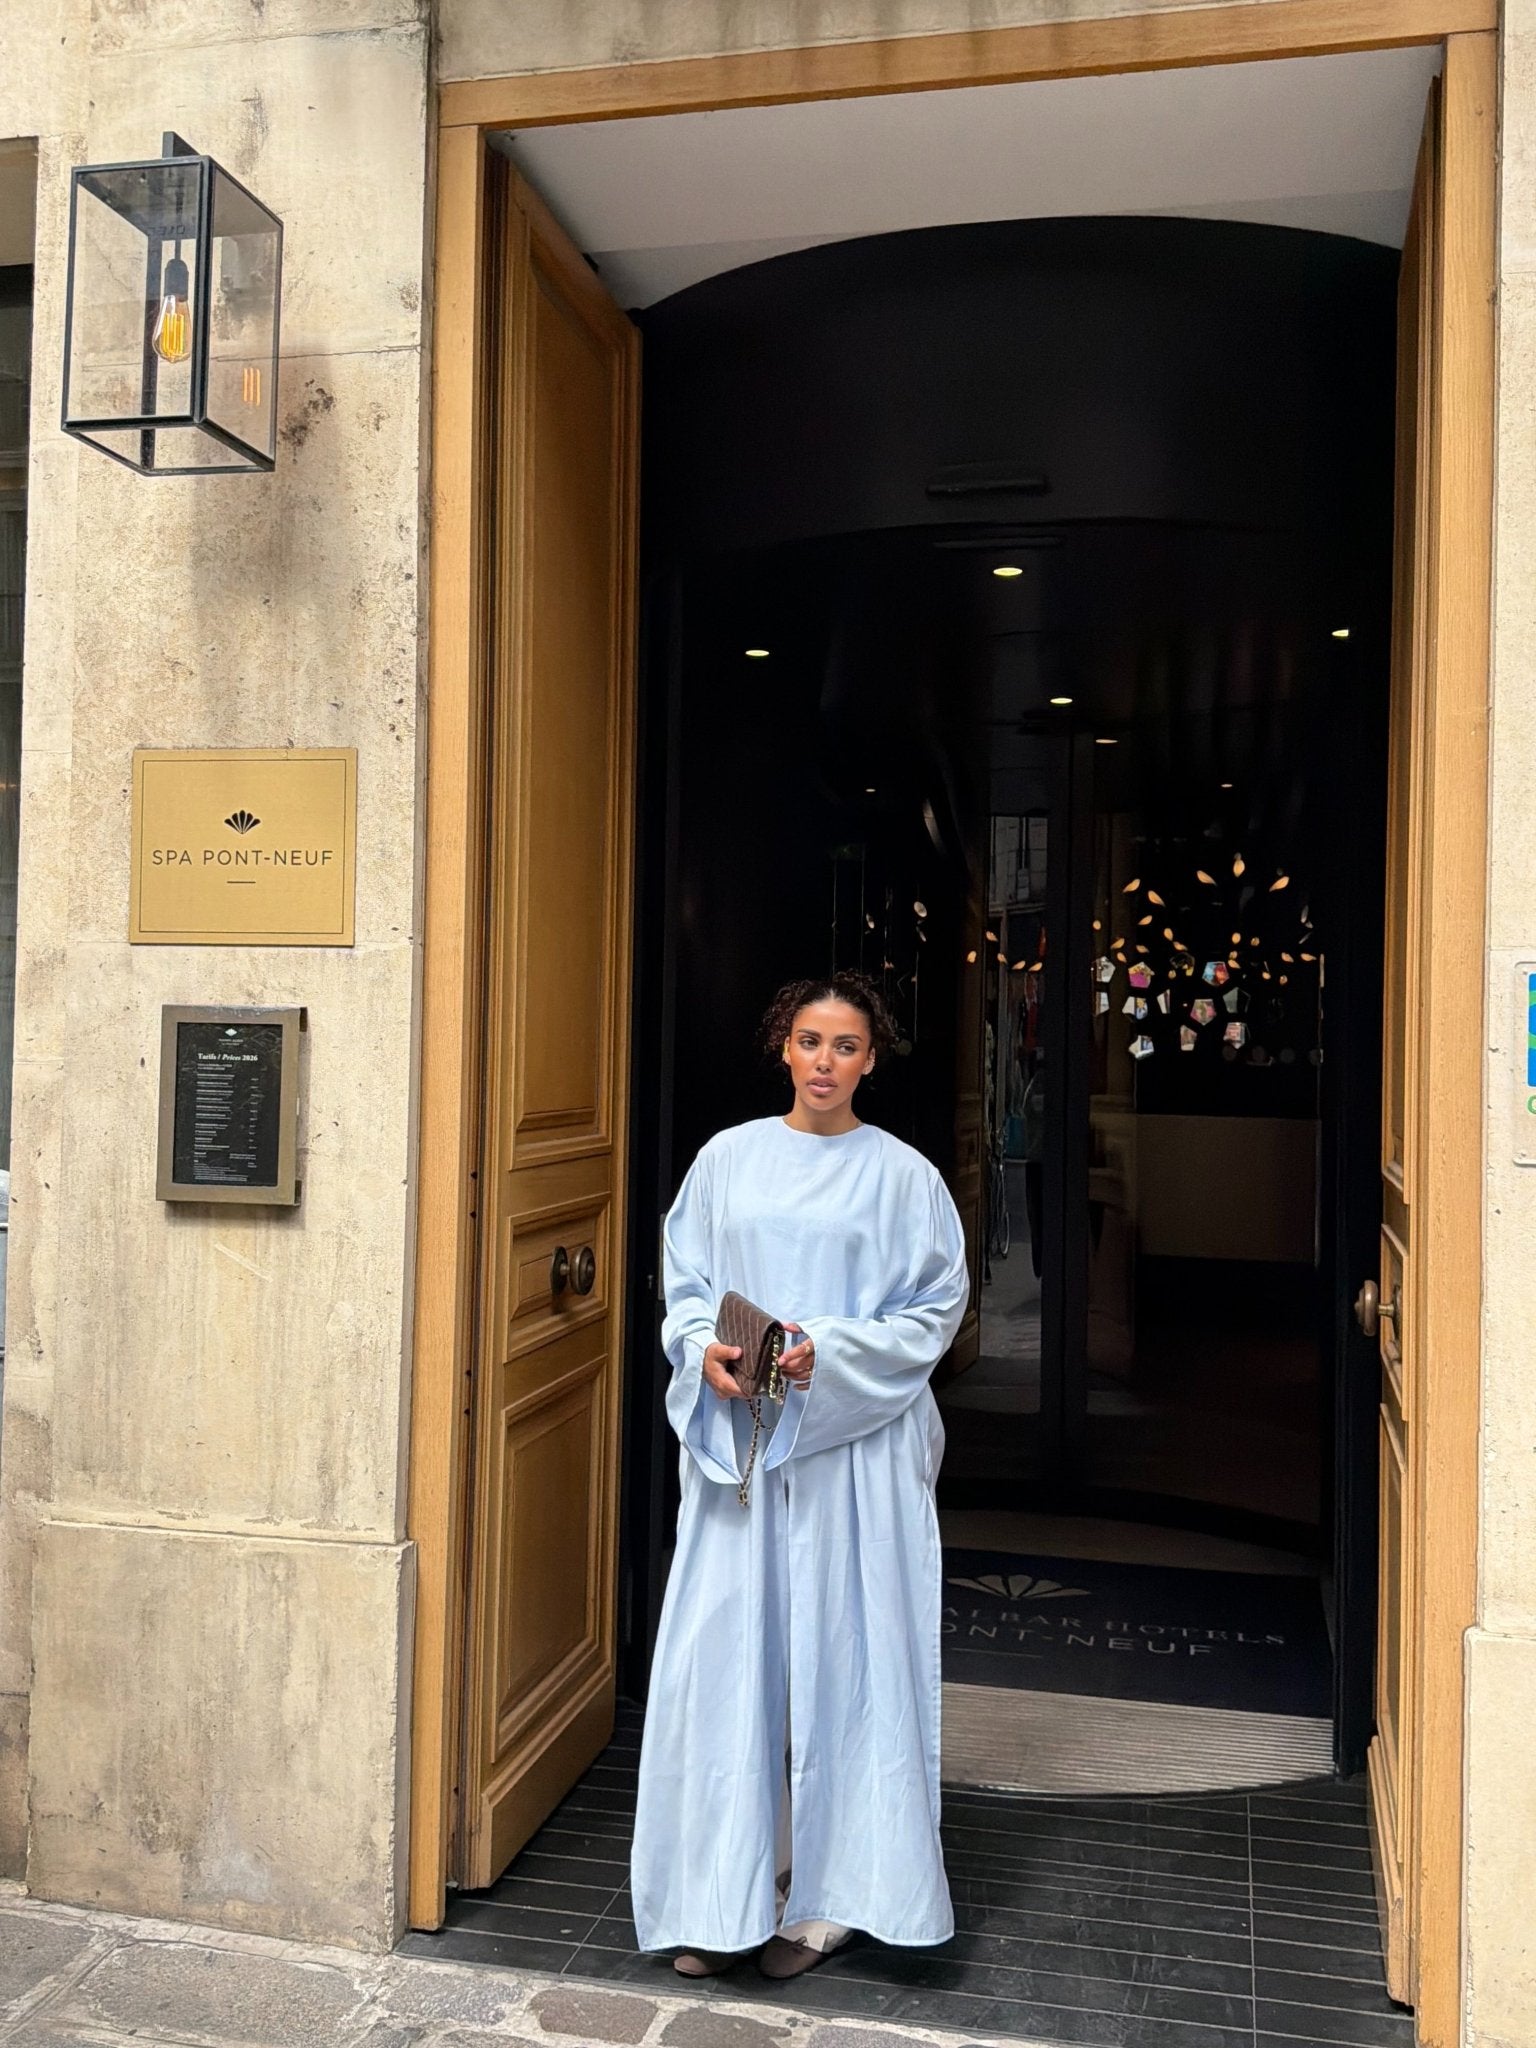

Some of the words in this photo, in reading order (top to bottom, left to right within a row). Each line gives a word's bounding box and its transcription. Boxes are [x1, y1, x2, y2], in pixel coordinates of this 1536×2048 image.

[152, 849, 193, 866] SPA
[203, 849, 334, 867] PONT-NEUF
[941, 1621, 1213, 1656] ONT-NEUF
